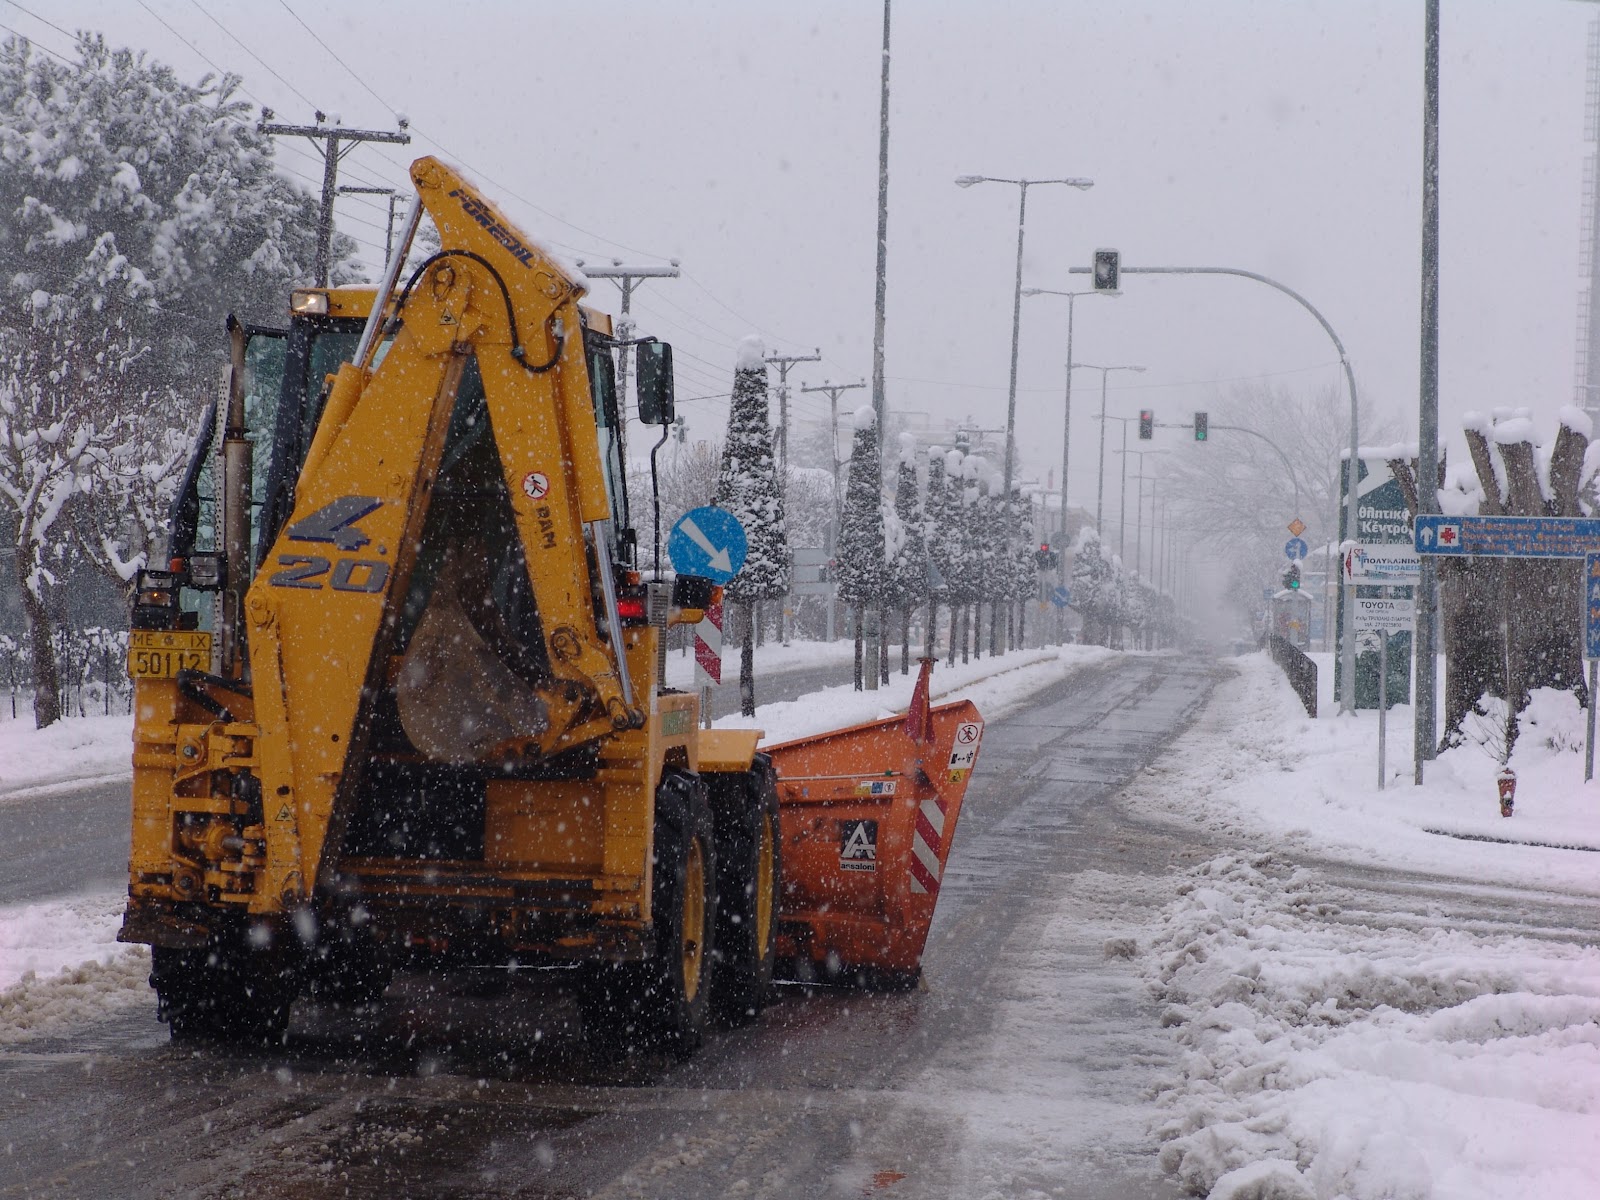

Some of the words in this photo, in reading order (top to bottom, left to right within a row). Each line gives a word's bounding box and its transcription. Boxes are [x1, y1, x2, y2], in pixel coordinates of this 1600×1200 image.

[269, 554, 390, 593] 20
[1360, 601, 1395, 610] TOYOTA
[137, 651, 202, 678] 50112
